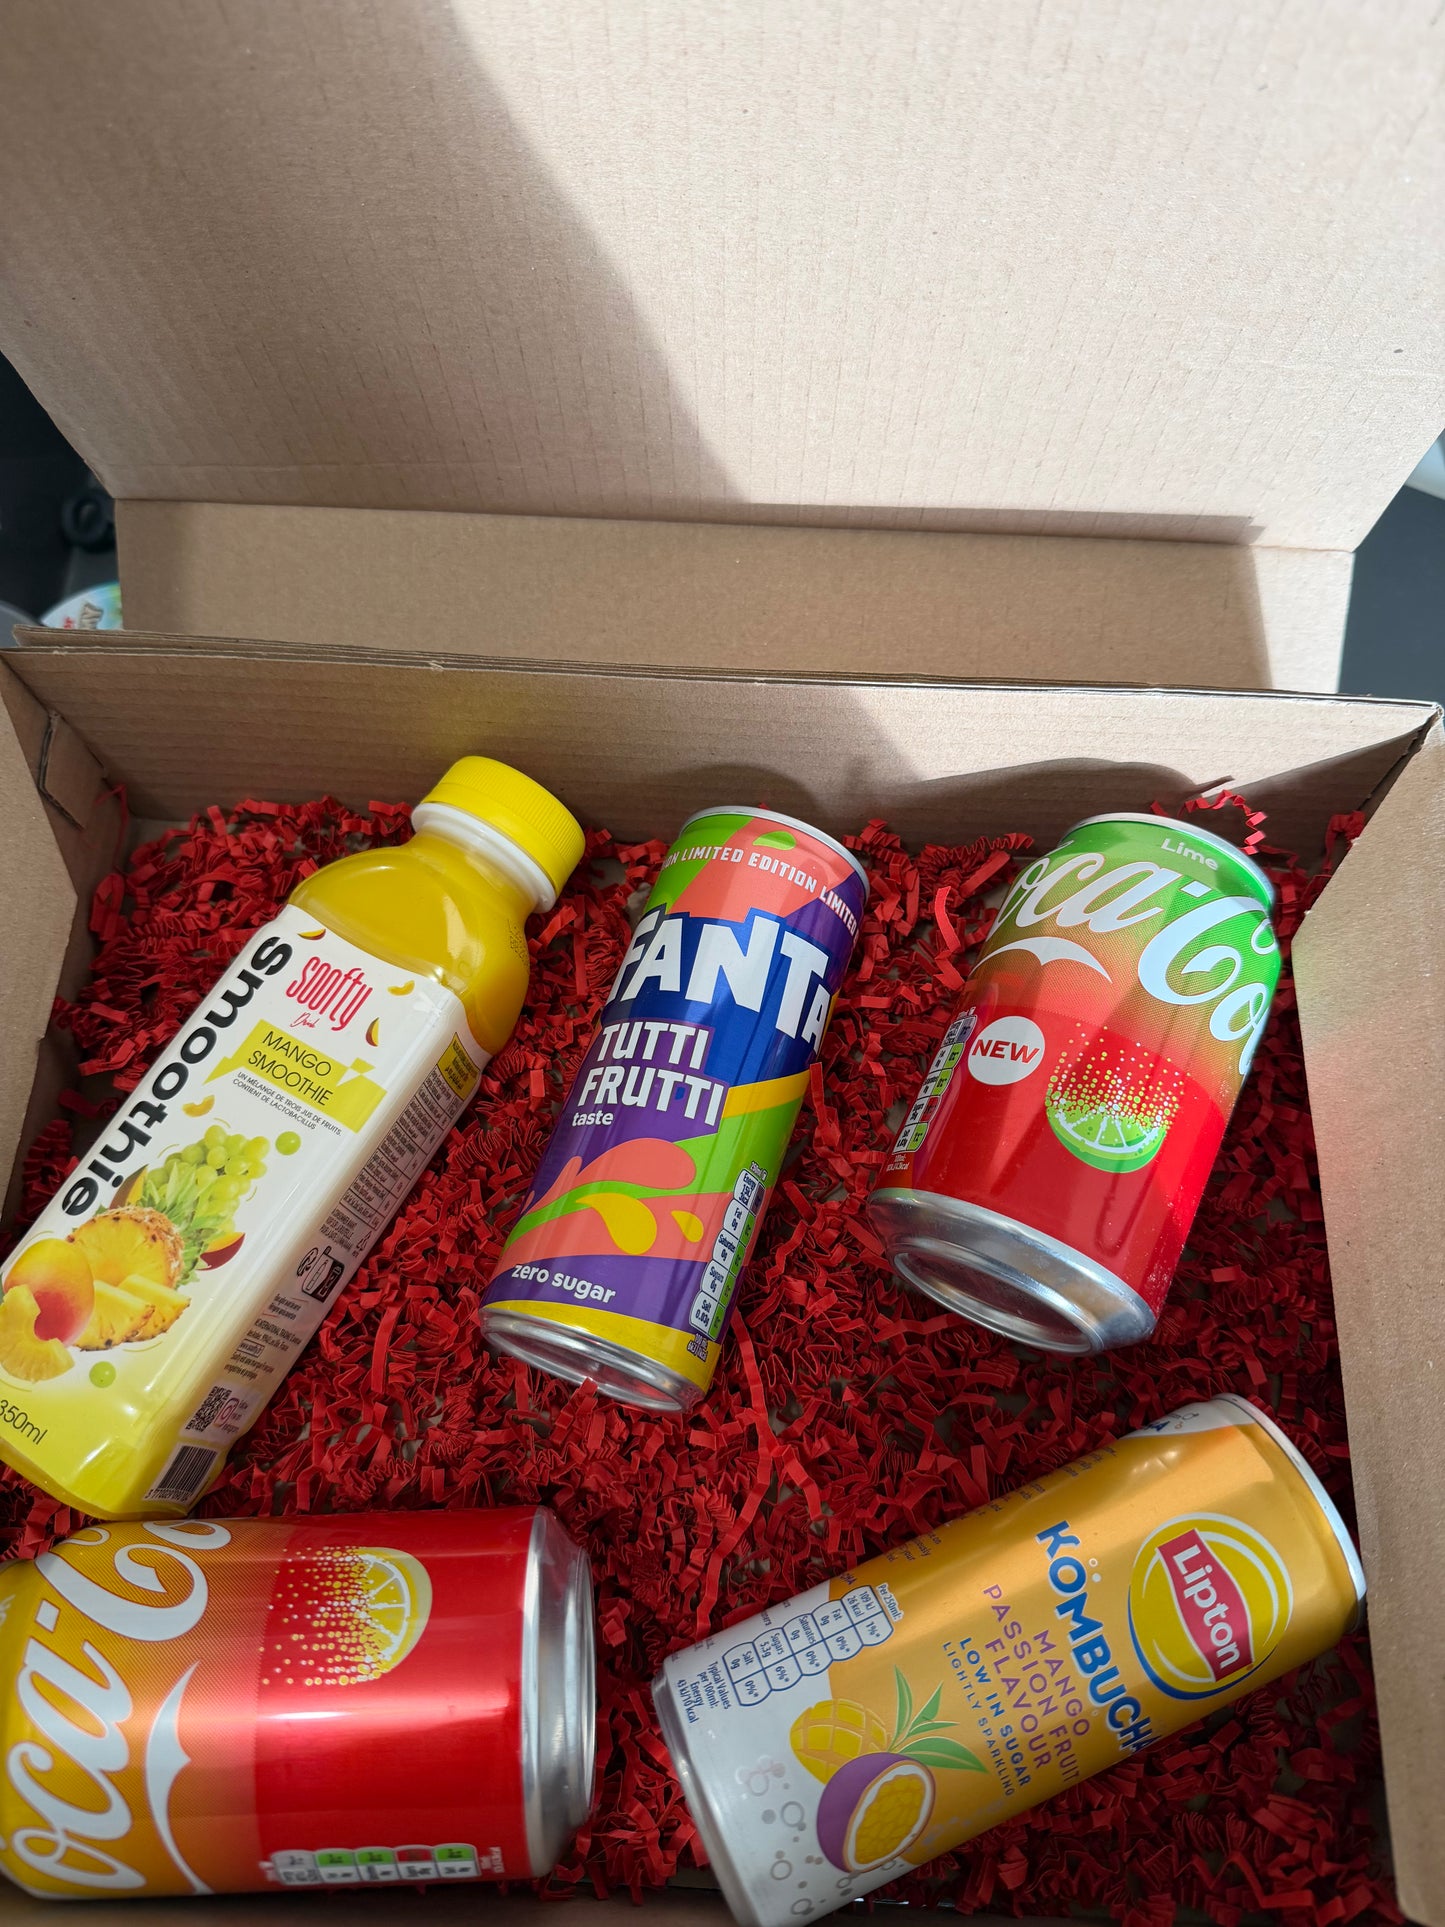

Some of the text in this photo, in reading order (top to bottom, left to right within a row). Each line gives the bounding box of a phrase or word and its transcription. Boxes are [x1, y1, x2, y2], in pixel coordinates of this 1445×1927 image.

[1160, 837, 1220, 872] Lime
[681, 846, 744, 863] LIMITED
[748, 852, 817, 893] EDITION
[819, 885, 858, 937] LIMITED
[606, 908, 835, 1055] FANTA
[262, 1031, 332, 1077] MANGO
[597, 1021, 709, 1070] TUTTI
[972, 1038, 1040, 1064] NEW
[248, 1050, 334, 1106] SMOOTHIE
[232, 1078, 317, 1130] CONTIENT DE LACTOBACILLUS
[237, 1071, 247, 1080] UN
[275, 1093, 285, 1103] DE
[284, 1098, 302, 1112] TROIS
[301, 1108, 313, 1118] JUS
[312, 1115, 321, 1123] DE
[578, 1066, 727, 1127] FRUTTI
[571, 1108, 615, 1128] taste
[512, 1262, 616, 1305] zero sugar
[701, 1299, 711, 1313] Salt
[0, 1399, 48, 1445] 350ml
[832, 1609, 842, 1621] Fat
[847, 1596, 856, 1606] 26
[851, 1603, 864, 1618] kcal
[859, 1591, 872, 1603] 109
[878, 1584, 902, 1620] Per 250ml:
[1172, 1544, 1243, 1669] Lipton
[790, 1629, 800, 1641] 0g
[798, 1615, 817, 1644] Saturates
[821, 1615, 830, 1626] 0g
[742, 1650, 755, 1665] Salt
[770, 1632, 785, 1655] Sugars
[697, 1671, 709, 1682] per
[730, 1658, 741, 1670] 0g
[690, 1681, 704, 1706] Energy
[707, 1661, 731, 1709] Typical Values
[983, 1584, 1080, 1782] PASSION FRUIT
[1033, 1630, 1090, 1736] MANGO
[686, 1704, 700, 1723] kcal
[942, 1641, 1016, 1796] LIGHTLY SPARKLING
[960, 1637, 1032, 1786] LOW IN SUGAR
[985, 1638, 1052, 1768] FLAVOUR
